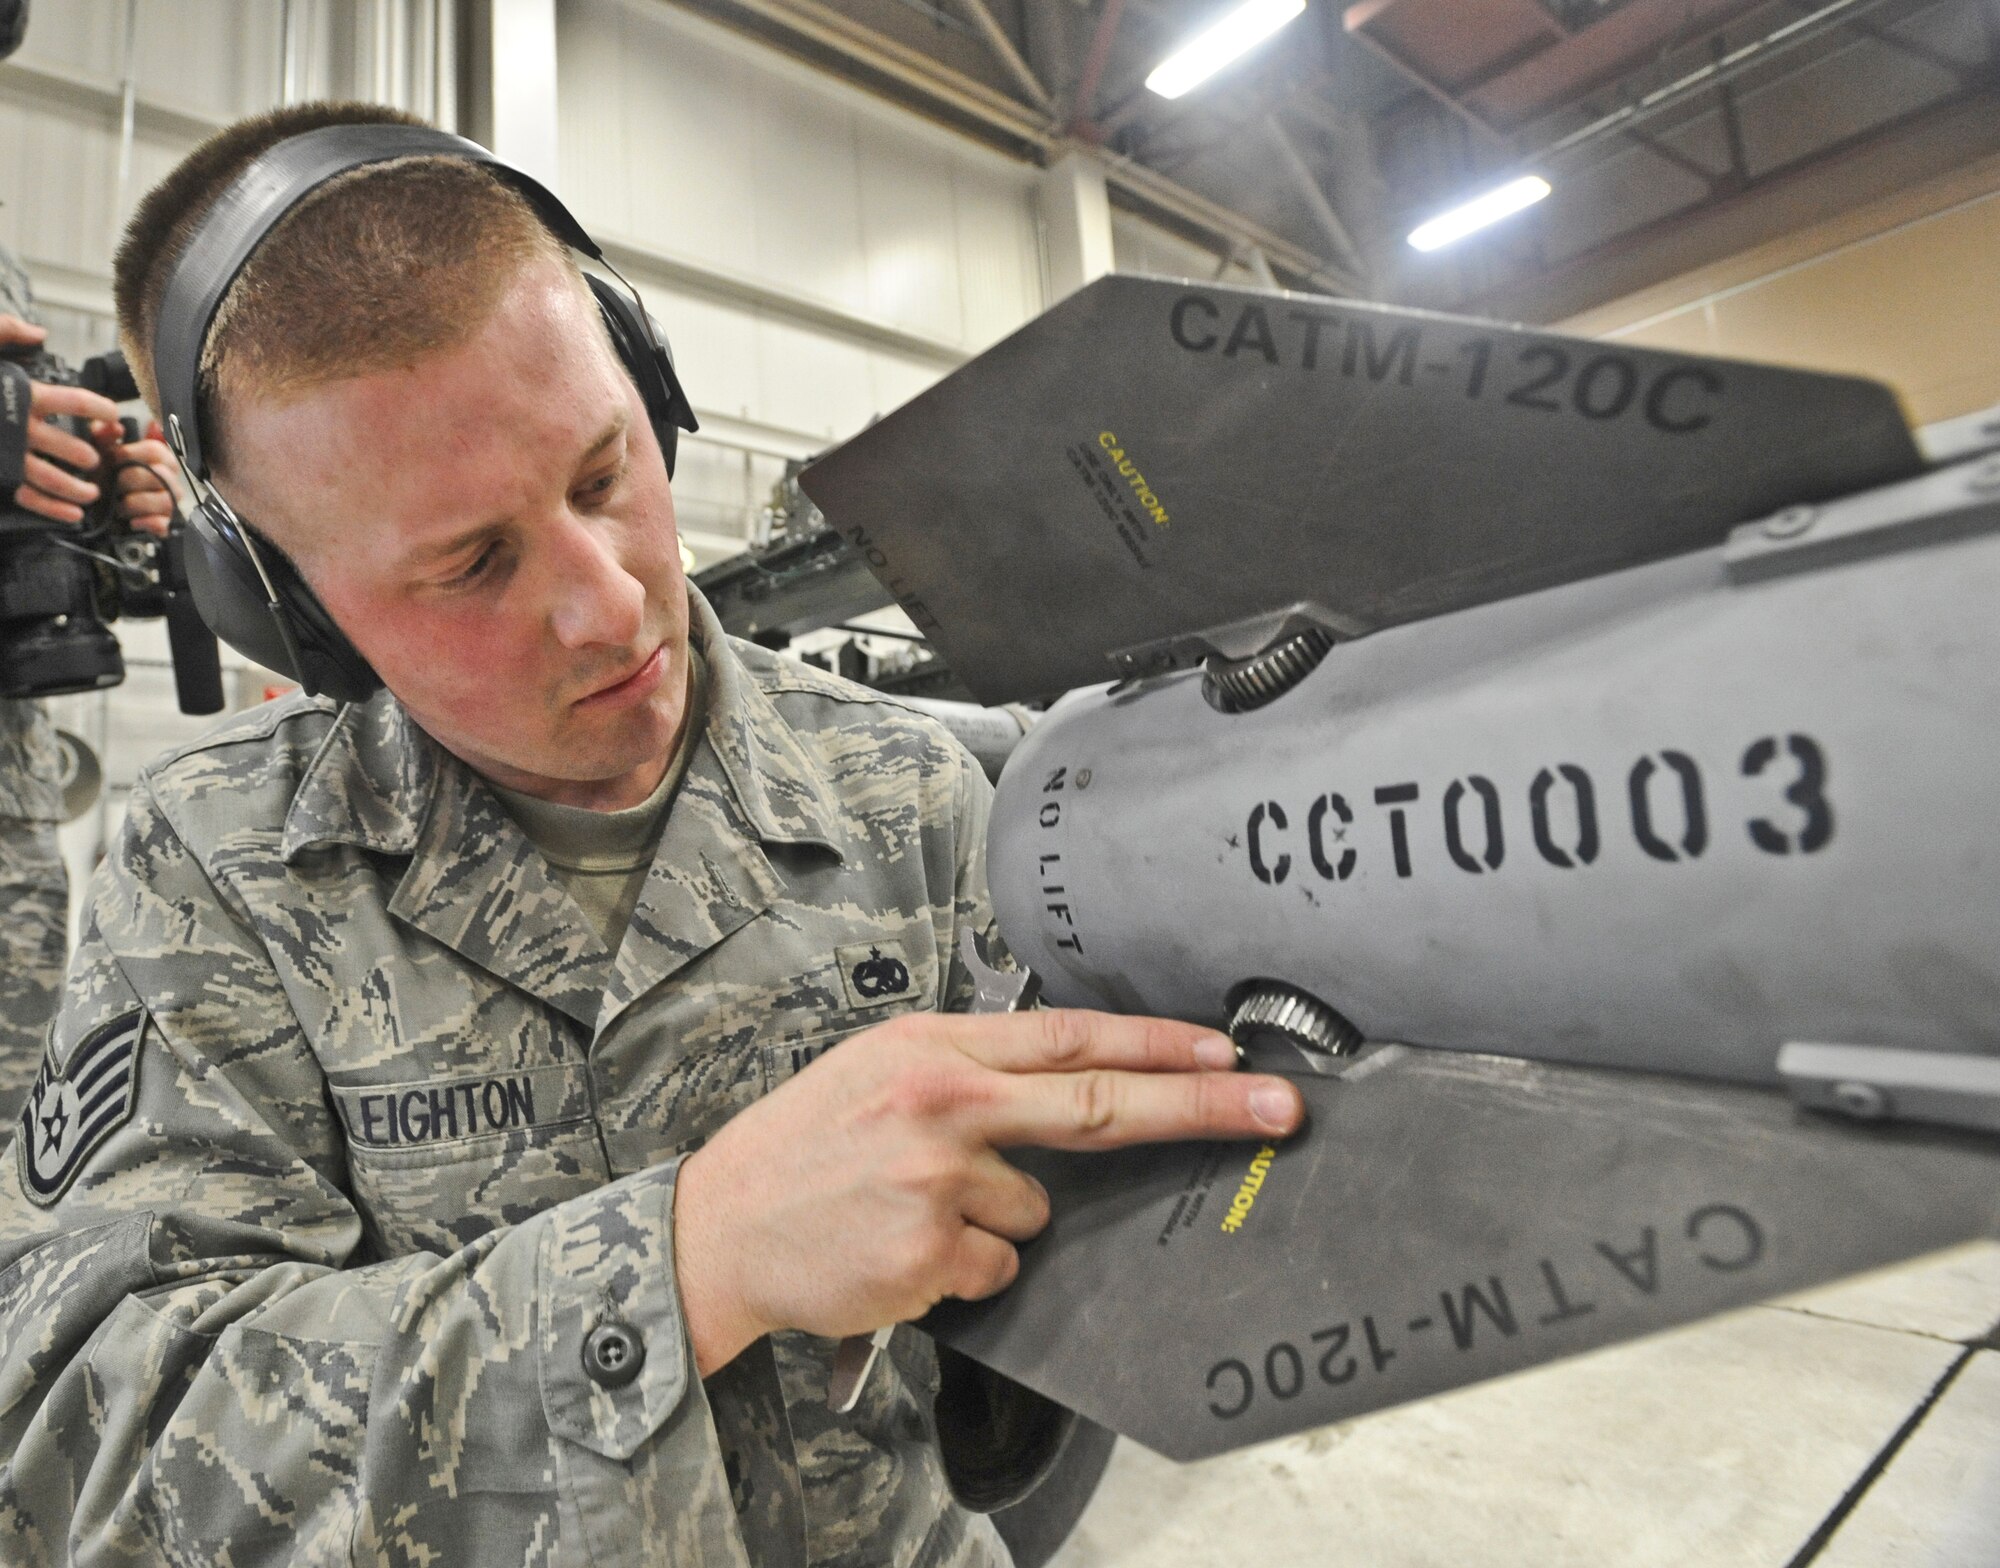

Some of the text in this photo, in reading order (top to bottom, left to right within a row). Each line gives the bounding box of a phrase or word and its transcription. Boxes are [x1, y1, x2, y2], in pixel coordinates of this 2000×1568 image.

[1169, 294, 1726, 434] CATM-120C
[846, 525, 943, 631] NO LIFT
[1039, 766, 1084, 955] NO LIFT
[1246, 733, 1837, 885] CCT0003
[337, 1075, 536, 1145] LEIGHTON
[1220, 1142, 1276, 1234] AUTION:
[1205, 1202, 1765, 1420] CATM-120C
